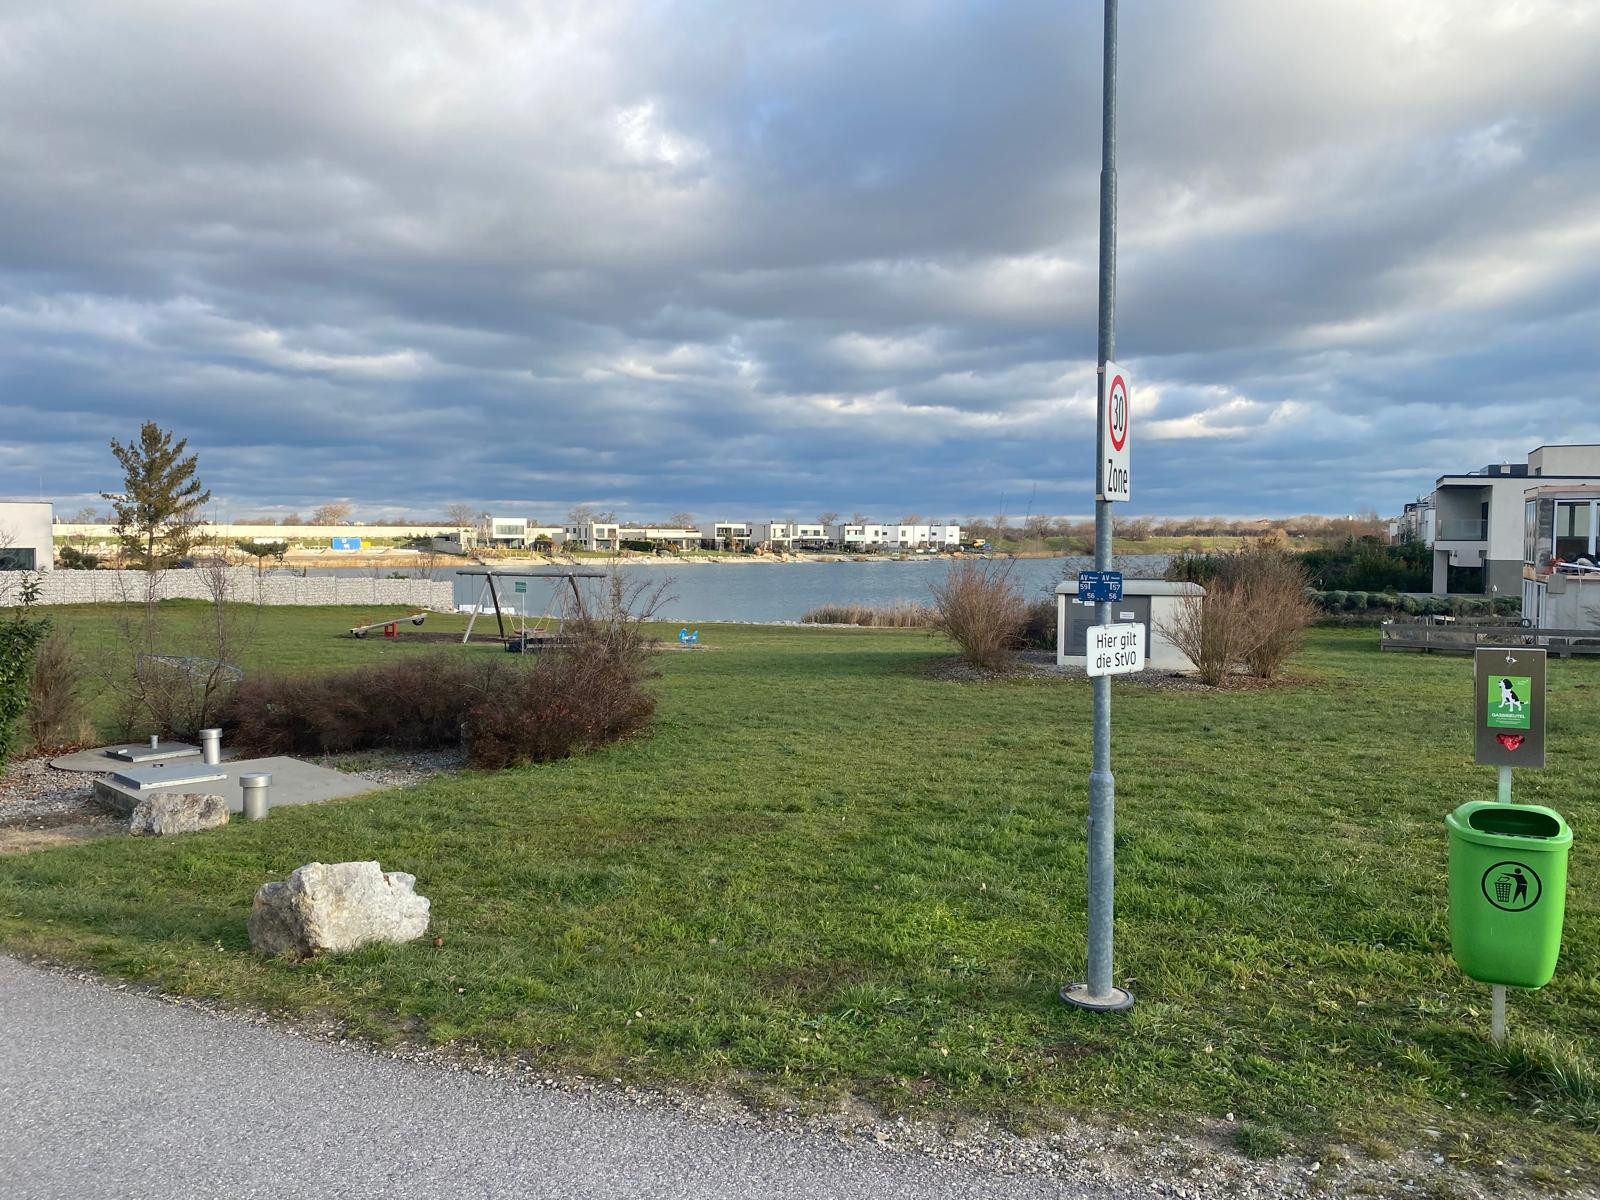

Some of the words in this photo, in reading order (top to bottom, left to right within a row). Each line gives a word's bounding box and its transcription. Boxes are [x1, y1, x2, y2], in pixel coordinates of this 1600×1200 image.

[1113, 394, 1124, 432] 30
[1108, 458, 1128, 494] Zone
[1096, 633, 1118, 649] Hier
[1120, 631, 1137, 650] gilt
[1096, 653, 1112, 669] die
[1114, 651, 1137, 667] StVO
